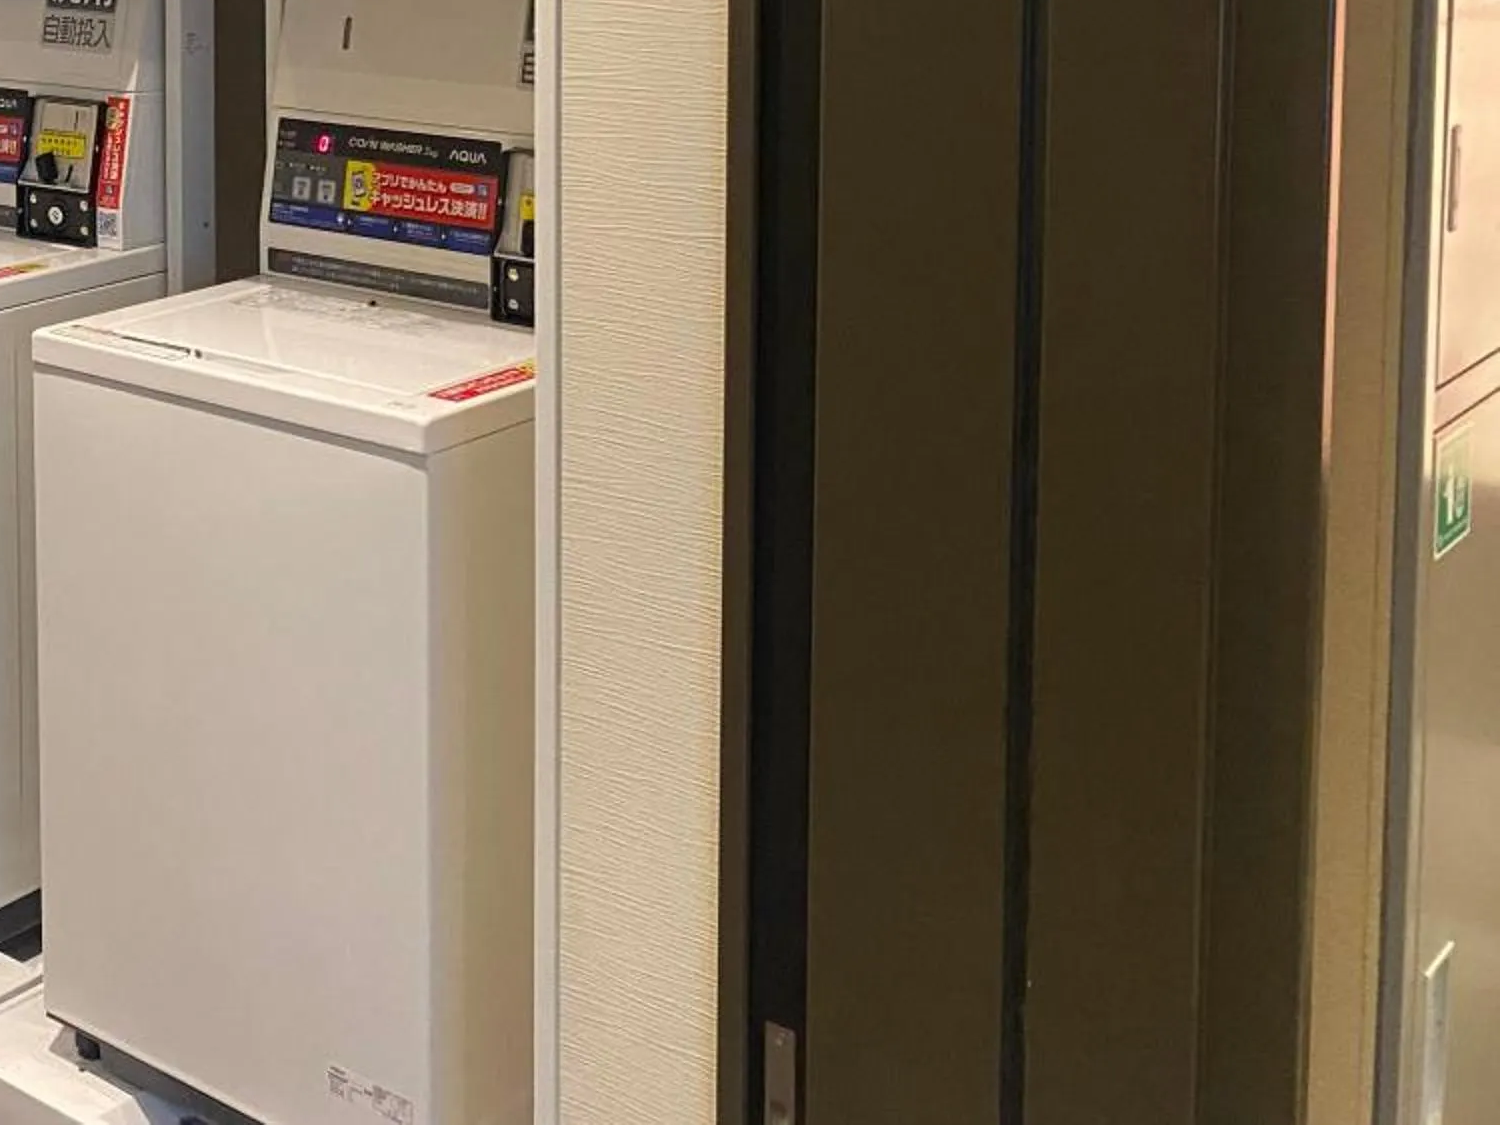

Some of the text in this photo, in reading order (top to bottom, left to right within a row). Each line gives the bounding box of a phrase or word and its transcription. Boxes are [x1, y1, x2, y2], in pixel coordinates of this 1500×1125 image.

[43, 16, 112, 49] 自動投入
[449, 149, 487, 165] AQUA
